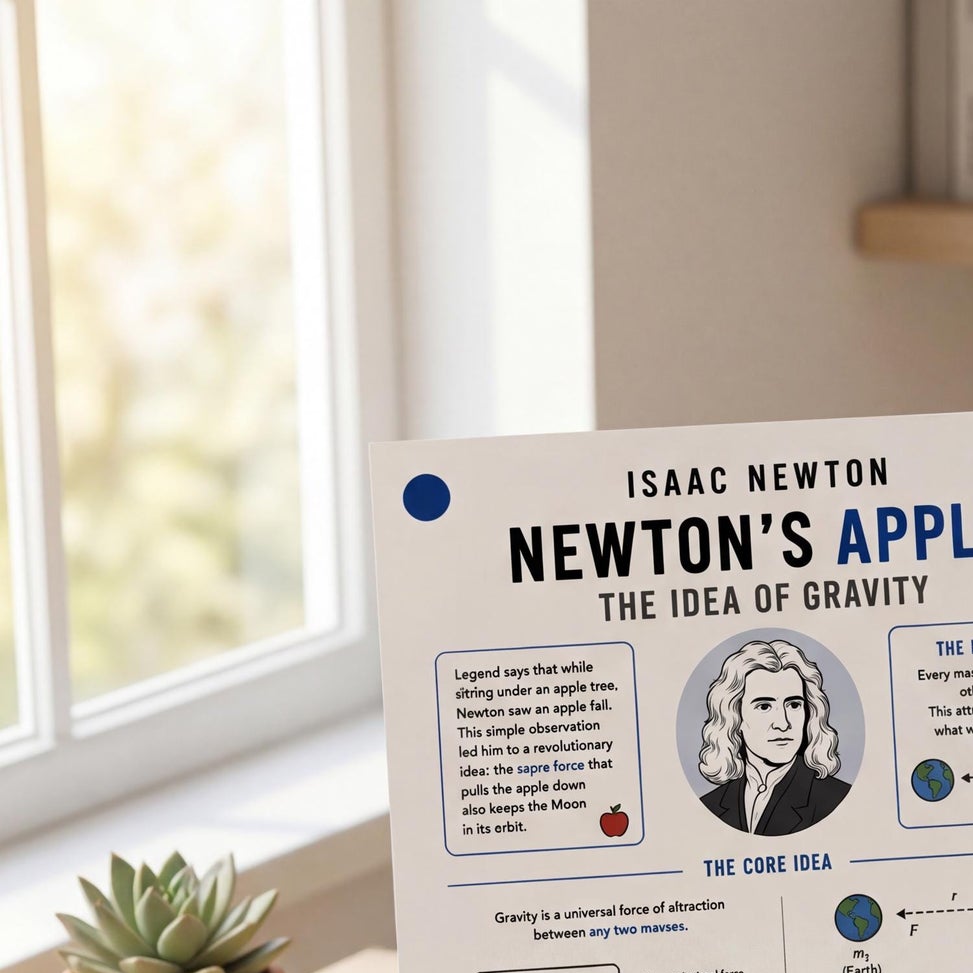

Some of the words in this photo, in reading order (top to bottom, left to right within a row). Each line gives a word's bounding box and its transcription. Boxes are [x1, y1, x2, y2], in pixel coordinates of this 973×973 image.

[627, 466, 727, 499] ISAAC
[748, 457, 888, 493] NEWTON
[509, 510, 813, 584] NEWTON'S
[598, 590, 657, 622] THE
[670, 585, 741, 618] IDEA
[754, 582, 790, 614] OF
[803, 575, 929, 611] GRAVITY
[935, 639, 965, 657] THE
[454, 665, 501, 683] Legend
[503, 667, 530, 681] says
[532, 662, 559, 676] that
[560, 660, 594, 674] while
[917, 669, 951, 683] Every
[456, 707, 505, 720] Newton
[508, 706, 532, 717] saw
[535, 705, 550, 715] an
[553, 699, 587, 717] apple
[589, 698, 613, 712] fall.
[934, 723, 964, 737] what
[462, 803, 486, 816] also
[489, 802, 525, 817] keeps
[527, 799, 548, 812] the
[551, 798, 587, 811] Moon
[703, 858, 736, 878] THE
[743, 855, 787, 875] CORE
[793, 853, 832, 872] IDEA
[952, 892, 957, 901] r
[494, 910, 538, 925] Gravity
[540, 909, 551, 921] is
[553, 911, 561, 920] a
[564, 904, 616, 920] universal
[618, 903, 650, 916] force
[652, 900, 666, 914] of
[909, 924, 918, 936] F
